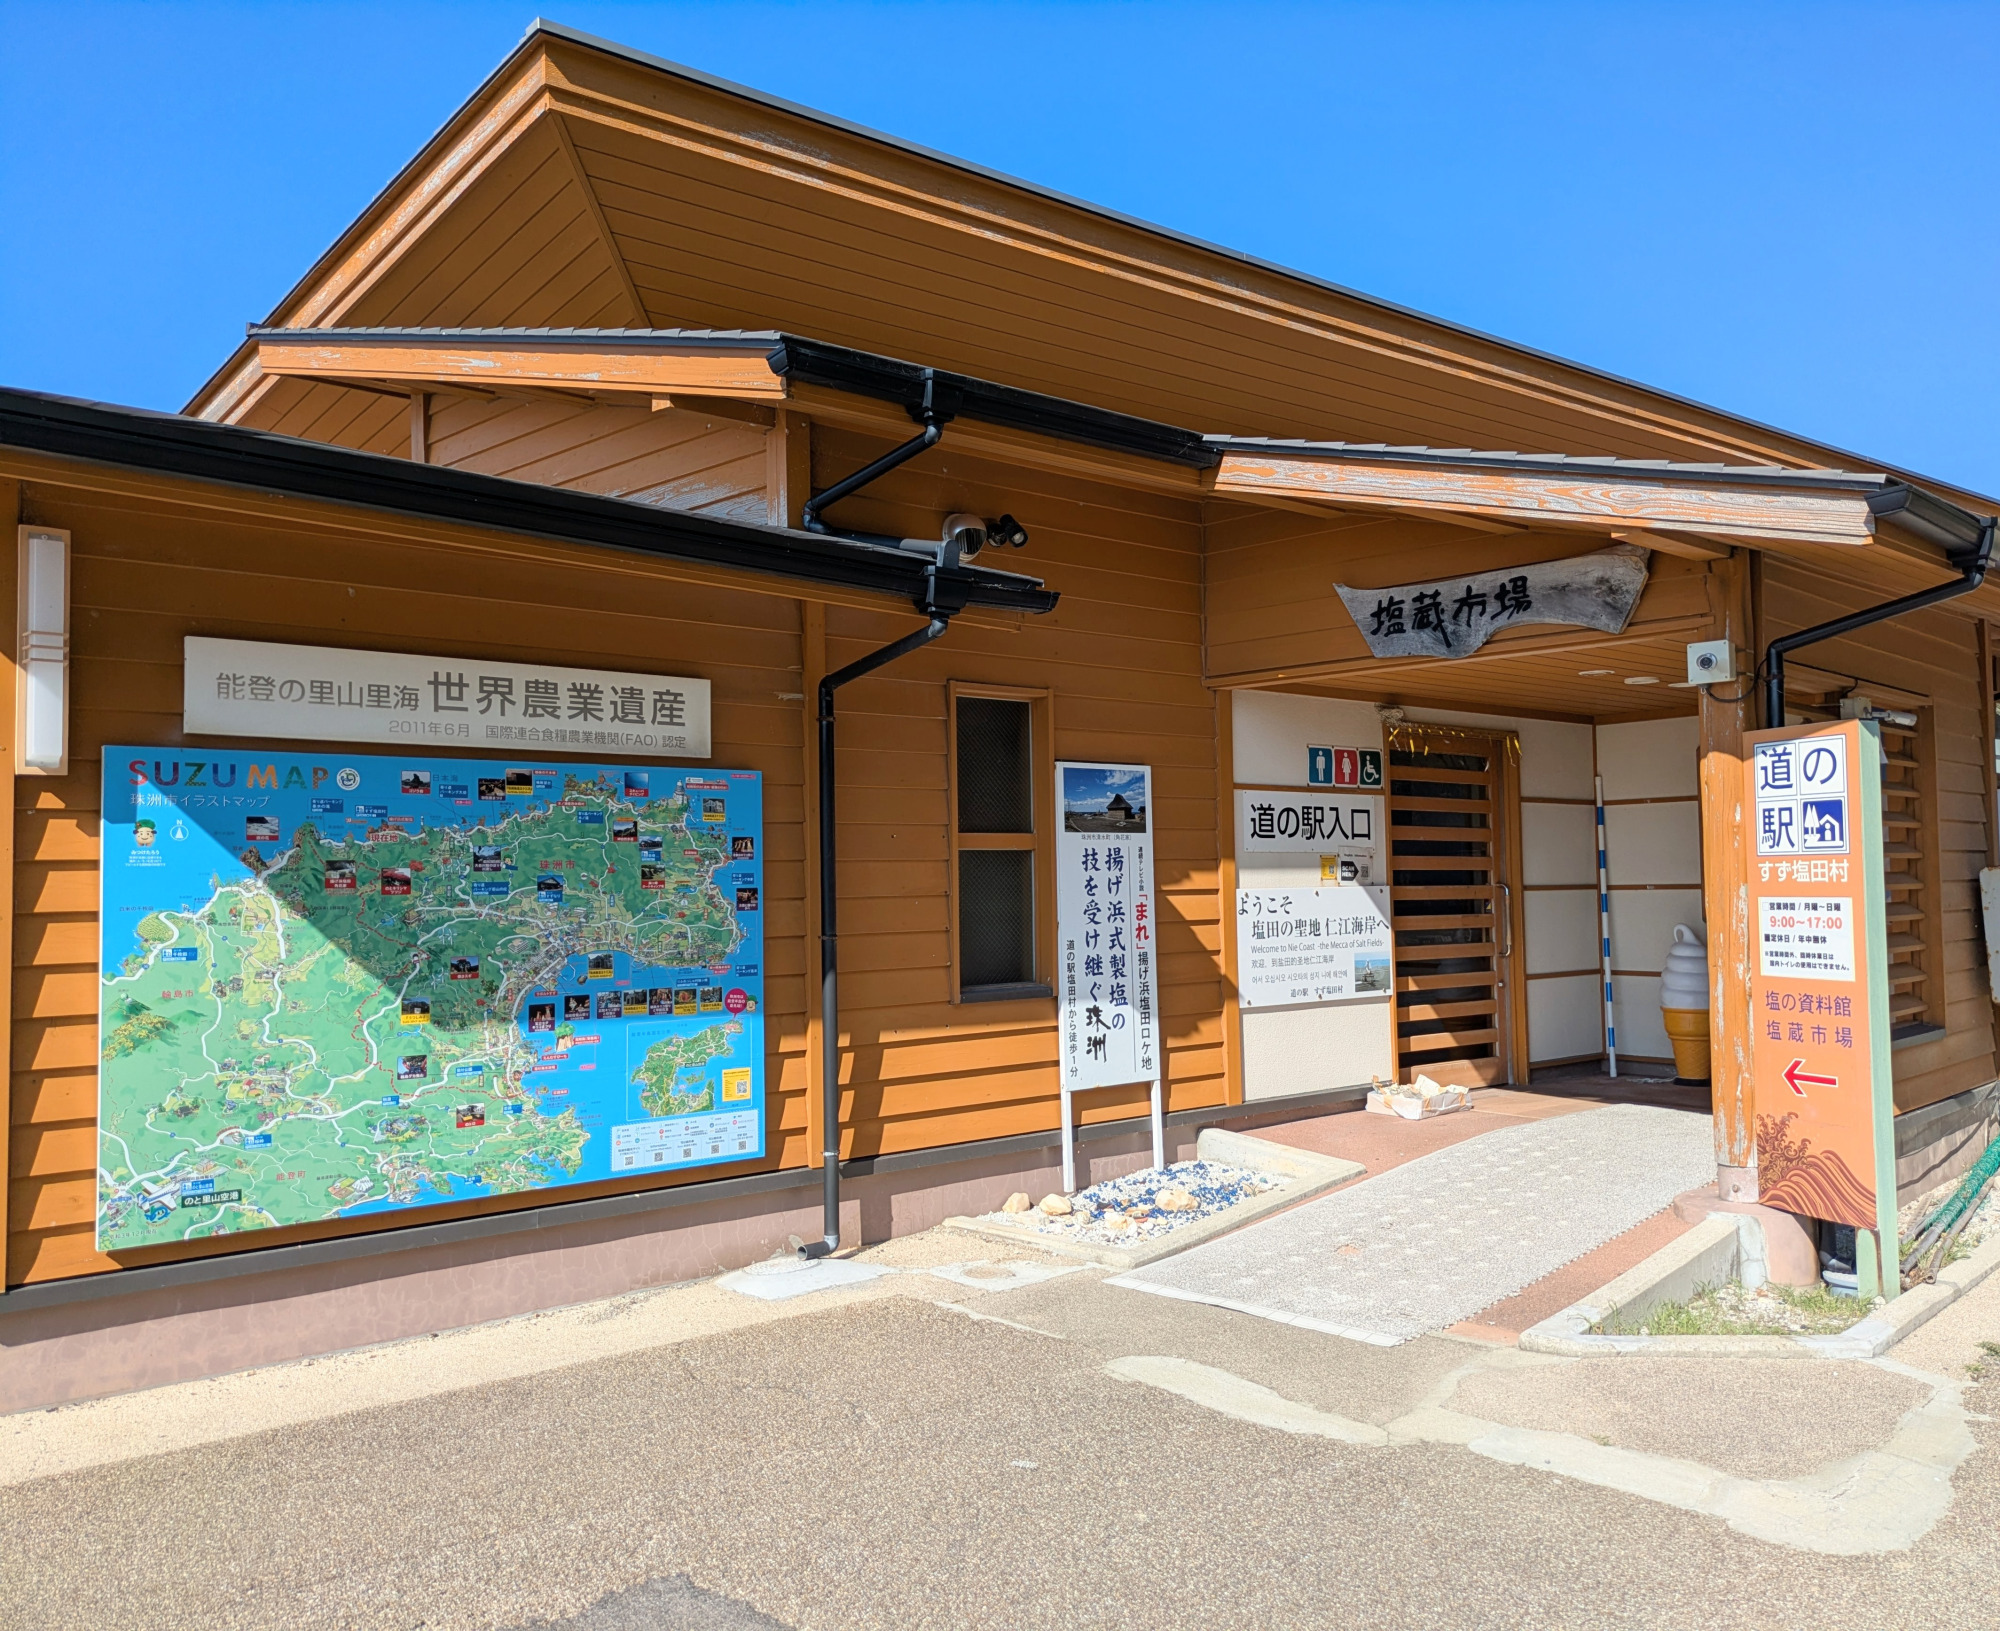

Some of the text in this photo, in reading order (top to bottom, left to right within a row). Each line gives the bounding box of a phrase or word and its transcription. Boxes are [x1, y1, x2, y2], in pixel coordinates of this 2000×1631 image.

[1370, 575, 1532, 648] 塩蔵市場
[389, 720, 471, 738] 2011年6月
[661, 735, 687, 750] 認定
[128, 760, 329, 790] SUZU MAP
[130, 793, 271, 808] 珠洲市イラストマップ
[1250, 803, 1371, 841] 道の駅入口
[1757, 859, 1850, 883] すず塩田村
[1237, 895, 1293, 916] ようこそ
[1769, 902, 1796, 912] 営業時間
[1105, 847, 1129, 1030] 揚げ浜式製塩の
[1251, 915, 1390, 940] 塩田の聖地 仁江海岸へ
[1798, 935, 1827, 944] 年中無休
[1250, 944, 1280, 954] Welcome
[1280, 944, 1287, 953] to
[1287, 943, 1298, 952] Nie
[1298, 942, 1315, 951] Coast
[1330, 940, 1349, 949] Mecca
[1355, 938, 1366, 948] Salt
[1290, 985, 1344, 998] 道の駅 すず塩田村
[1765, 990, 1852, 1017] 塩の資料館
[1766, 1019, 1853, 1049] 塩蔵市場
[184, 1192, 240, 1205] のと里山空港
